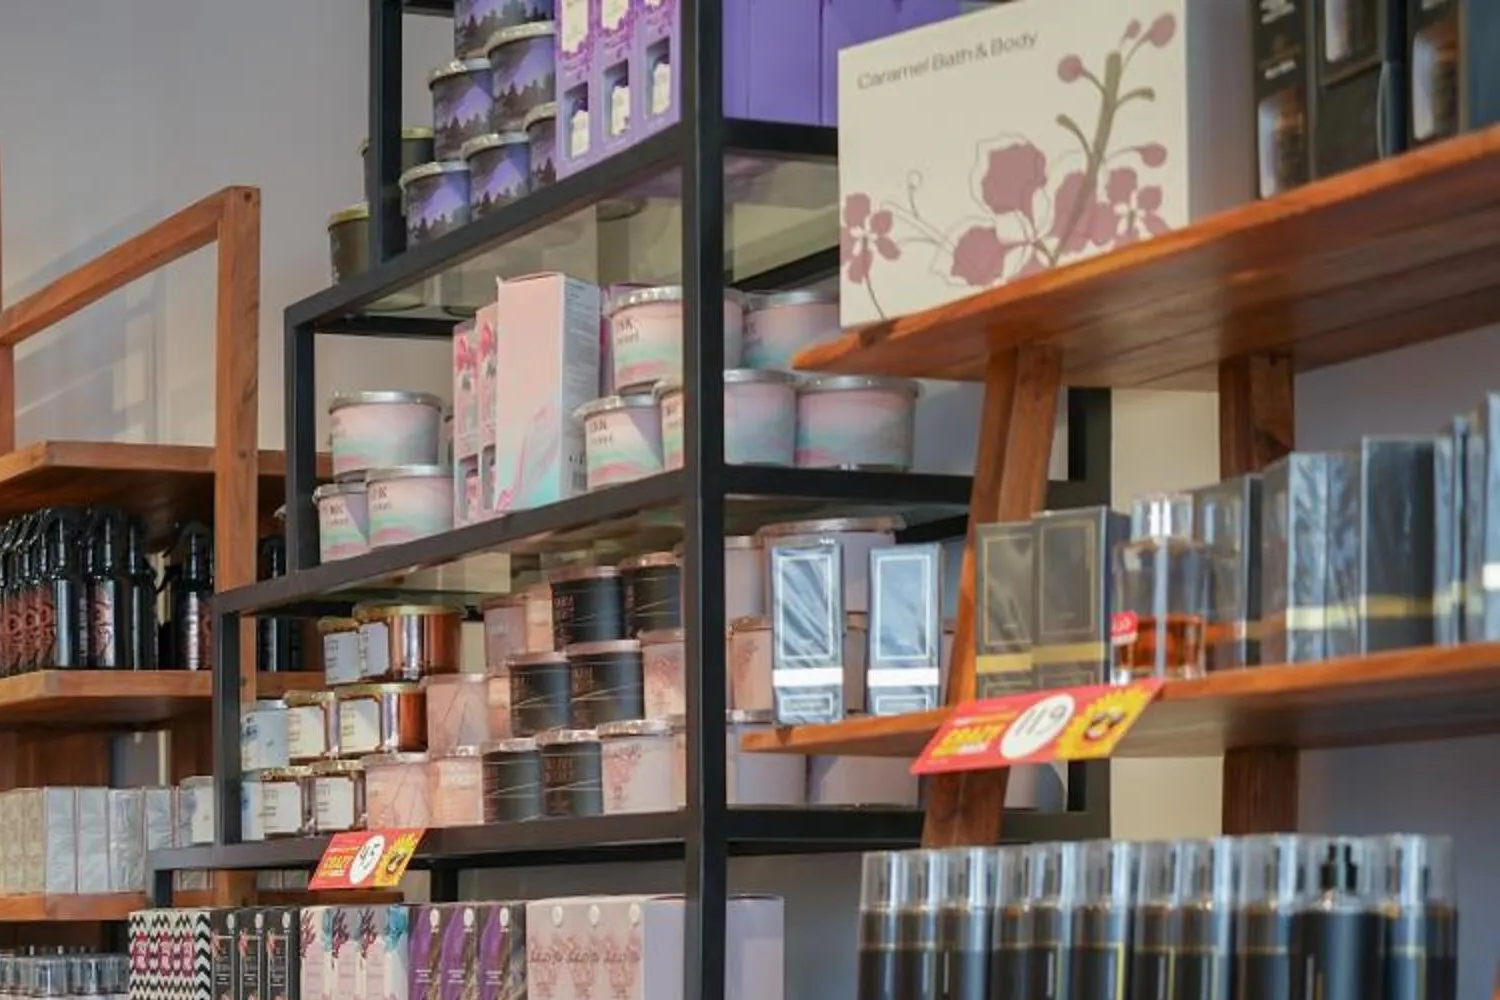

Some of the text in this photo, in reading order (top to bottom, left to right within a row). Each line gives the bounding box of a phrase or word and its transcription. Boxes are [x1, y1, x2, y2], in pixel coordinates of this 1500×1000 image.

[857, 31, 1039, 90] Caramel Bath & Body
